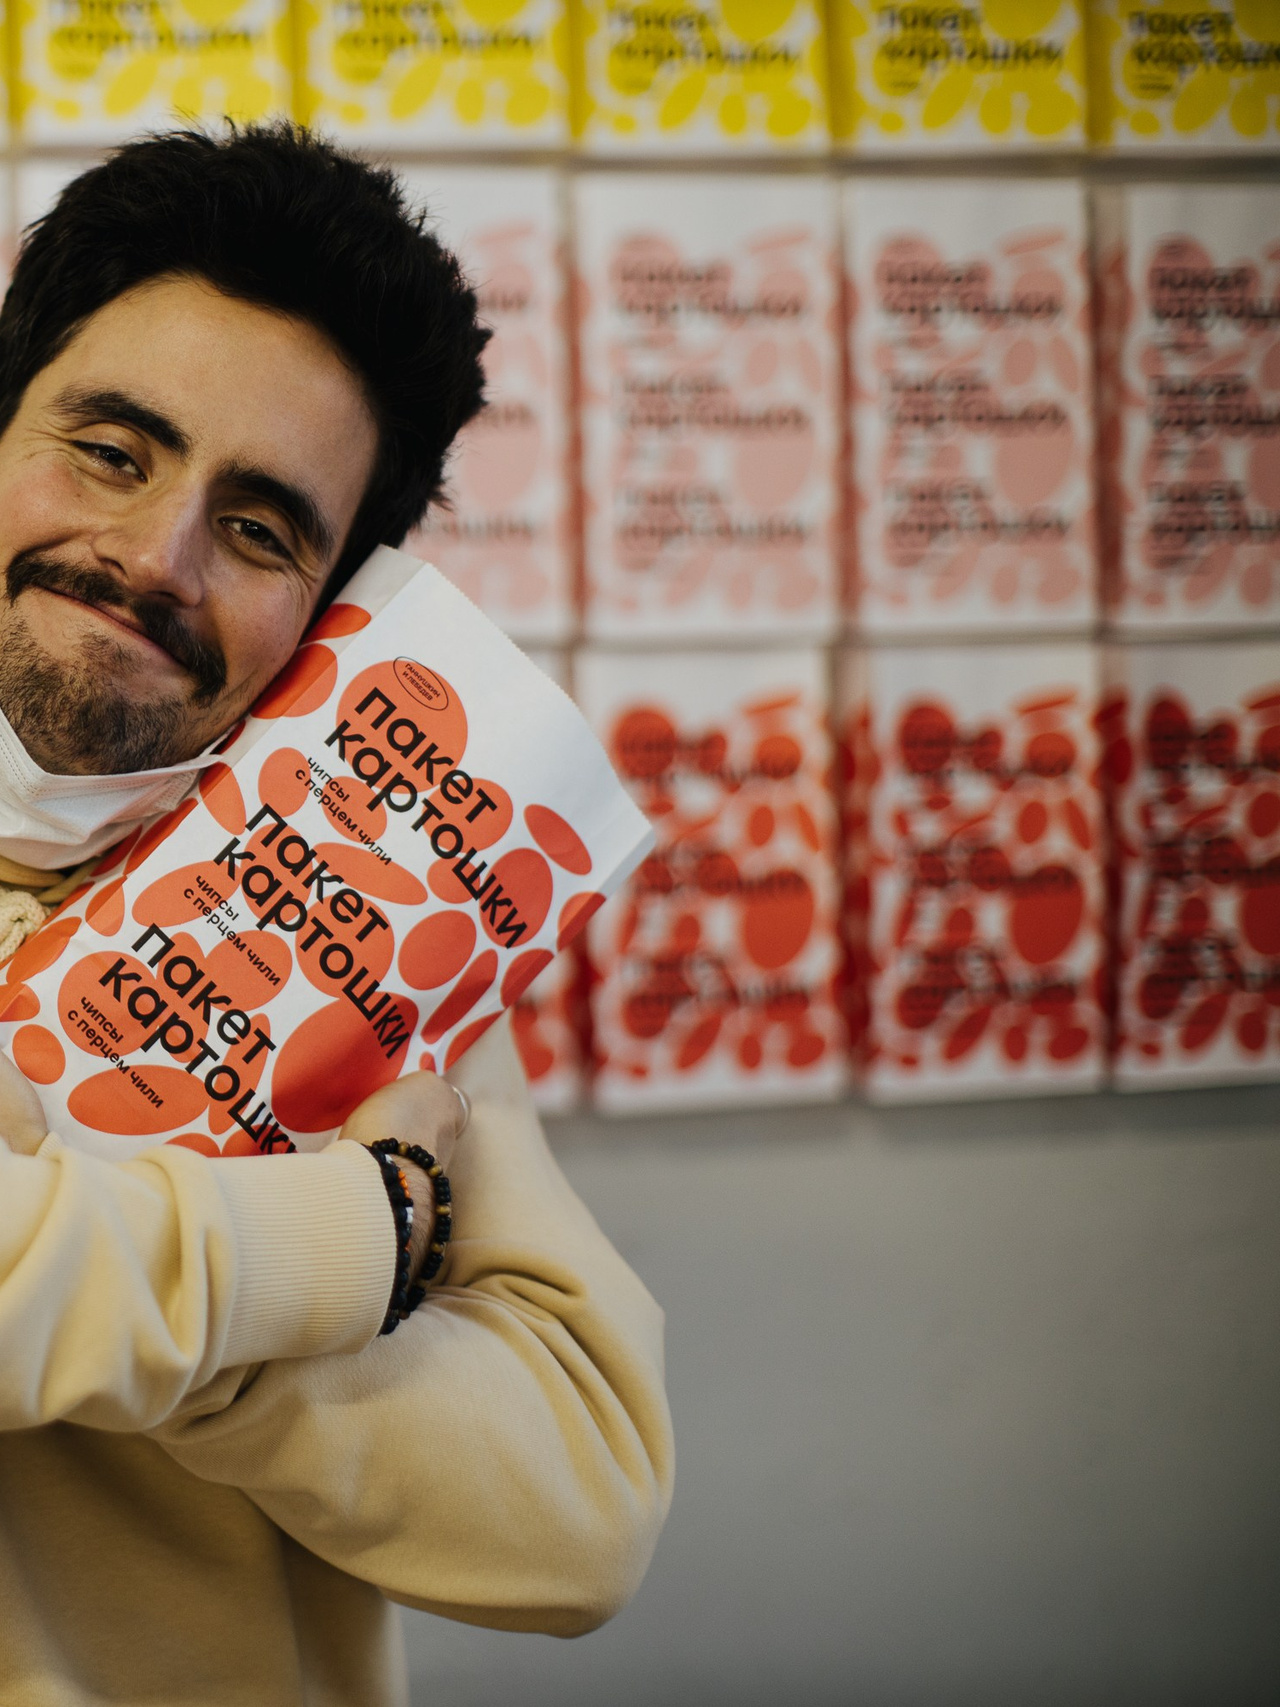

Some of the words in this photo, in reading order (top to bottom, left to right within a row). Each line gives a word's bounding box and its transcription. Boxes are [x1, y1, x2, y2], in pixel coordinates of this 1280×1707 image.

[405, 663, 441, 698] ГАННУШКИН
[407, 676, 434, 701] ЛЕБЕДЕВ
[307, 757, 350, 803] чипсы
[354, 686, 498, 824] пакет
[295, 769, 306, 781] с
[304, 779, 358, 834] перцем
[357, 831, 392, 866] чили
[324, 719, 528, 949] картошки
[195, 875, 240, 922] чипсы
[245, 803, 389, 943] пакет
[183, 887, 195, 899] с
[192, 896, 247, 952] перцем
[246, 949, 281, 986] чили
[212, 837, 411, 1059] картошки
[80, 996, 124, 1044] чипсы
[131, 922, 277, 1064] пакет
[67, 1009, 79, 1021] с
[76, 1018, 131, 1075] перцем
[129, 1070, 164, 1109] чили
